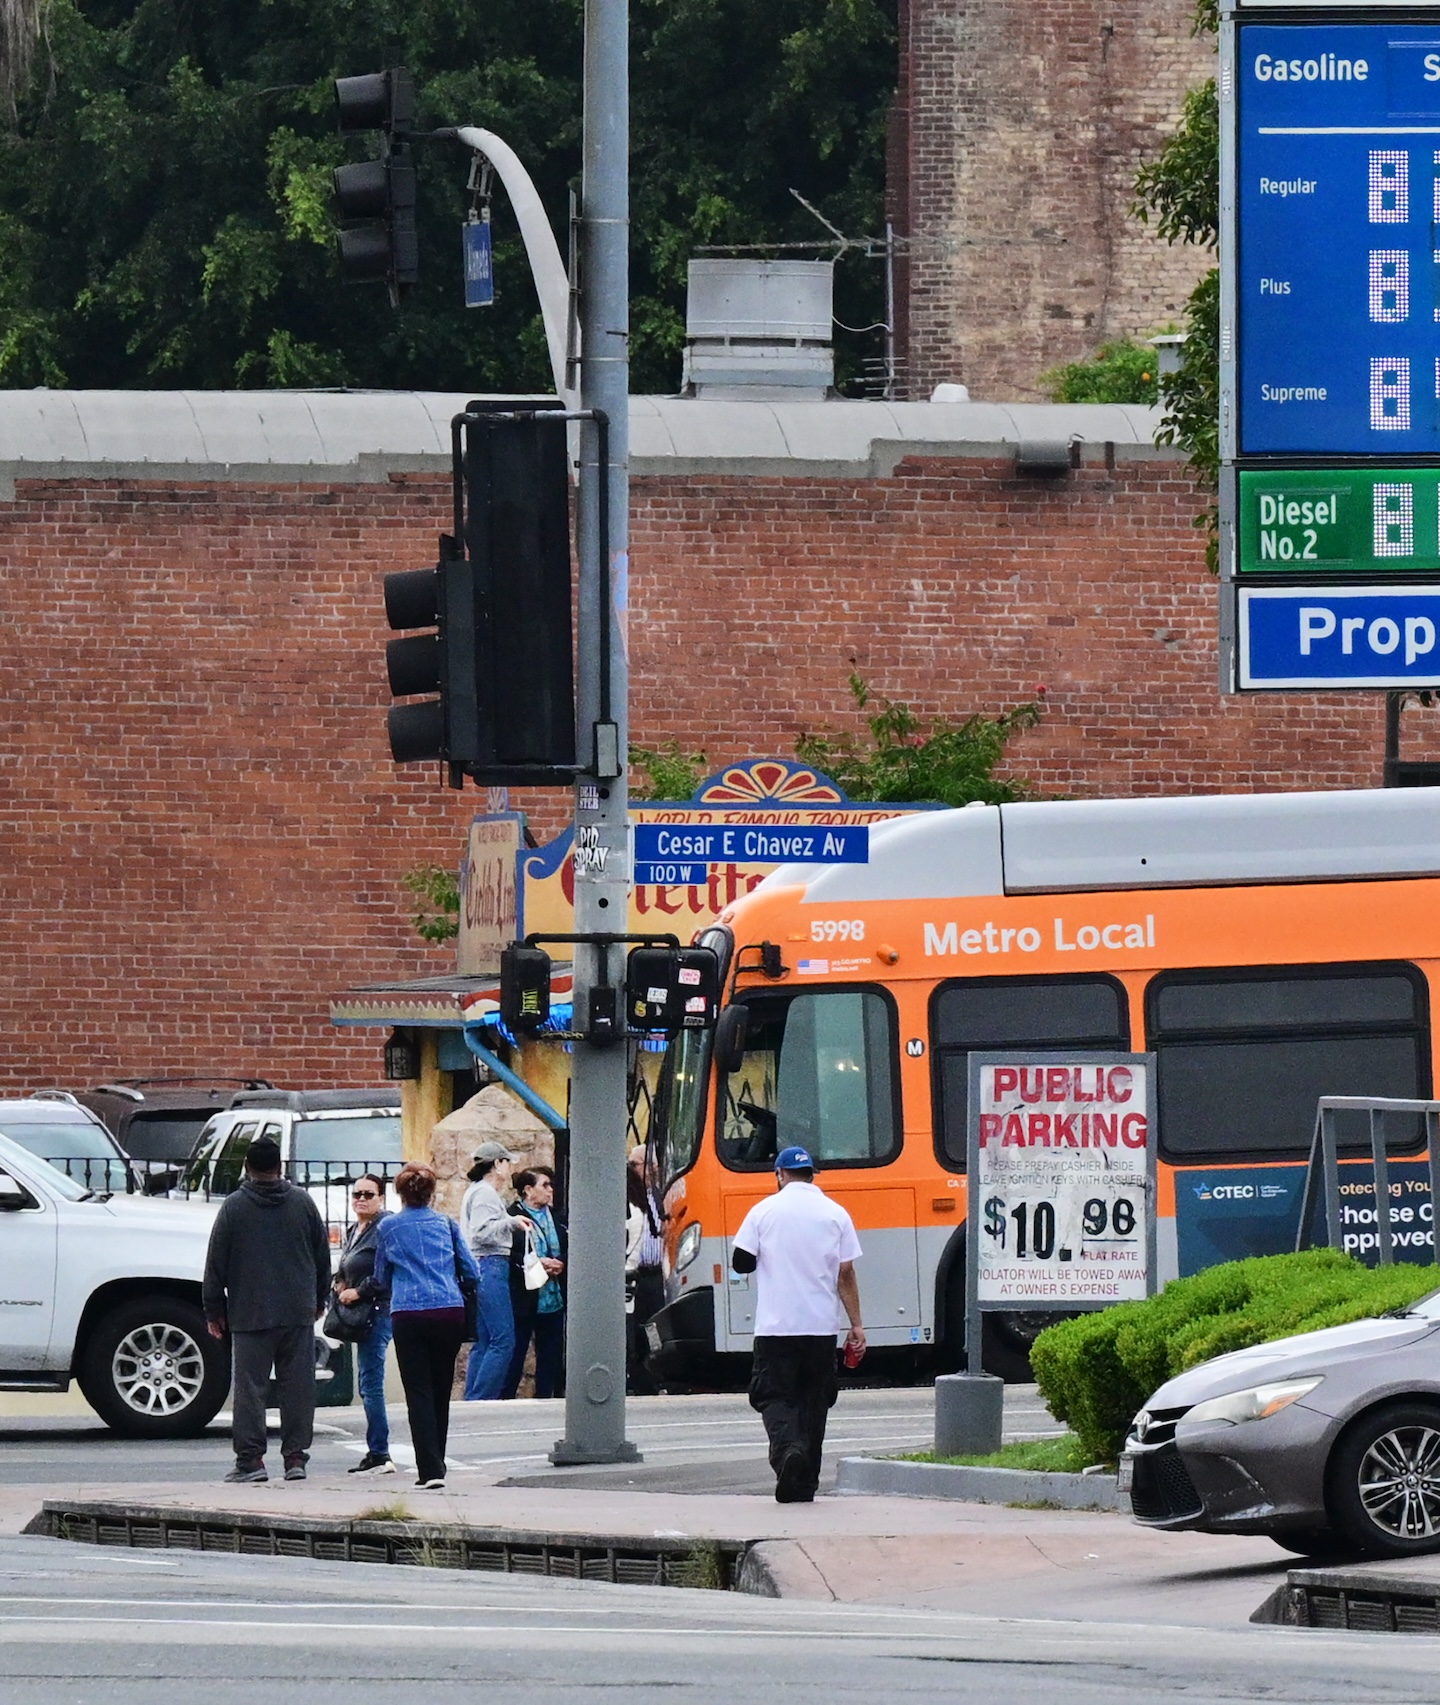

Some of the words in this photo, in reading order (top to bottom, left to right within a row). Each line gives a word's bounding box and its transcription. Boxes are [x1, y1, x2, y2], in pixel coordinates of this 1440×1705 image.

[1254, 53, 1369, 82] Gasoline
[1259, 177, 1317, 197] Regular
[1260, 278, 1291, 295] Plus
[1261, 383, 1327, 405] Supreme
[1260, 494, 1337, 527] Diesel
[1260, 529, 1319, 560] No.2
[658, 831, 714, 856] Cesar
[723, 831, 735, 856] E
[744, 830, 814, 857] Chavez
[823, 831, 846, 856] Av
[650, 864, 676, 883] 100
[678, 864, 692, 882] W
[810, 919, 866, 943] 5998
[923, 921, 1041, 957] Metro
[1053, 913, 1156, 952] Local
[993, 1066, 1133, 1104] PUBLIC
[979, 1112, 1148, 1149] PARKING
[987, 1160, 1023, 1171] PLEASE
[1024, 1160, 1059, 1171] PREPAY
[1061, 1160, 1101, 1171] CASHIER
[978, 1175, 1007, 1185] LEAVE
[1010, 1174, 1049, 1185] IGNITION
[1076, 1174, 1100, 1184] WITH
[1102, 1174, 1143, 1185] CASHIER
[1213, 1185, 1254, 1199] CTEC
[1083, 1251, 1107, 1261] FLAT
[1111, 1251, 1138, 1261] RATE
[1027, 1268, 1054, 1280] WILL
[1057, 1268, 1071, 1280] BE
[1073, 1268, 1114, 1280] TOWED
[1117, 1268, 1148, 1280] AWAY
[1000, 1283, 1014, 1295] AT
[1071, 1283, 1120, 1295] EXPENSE
